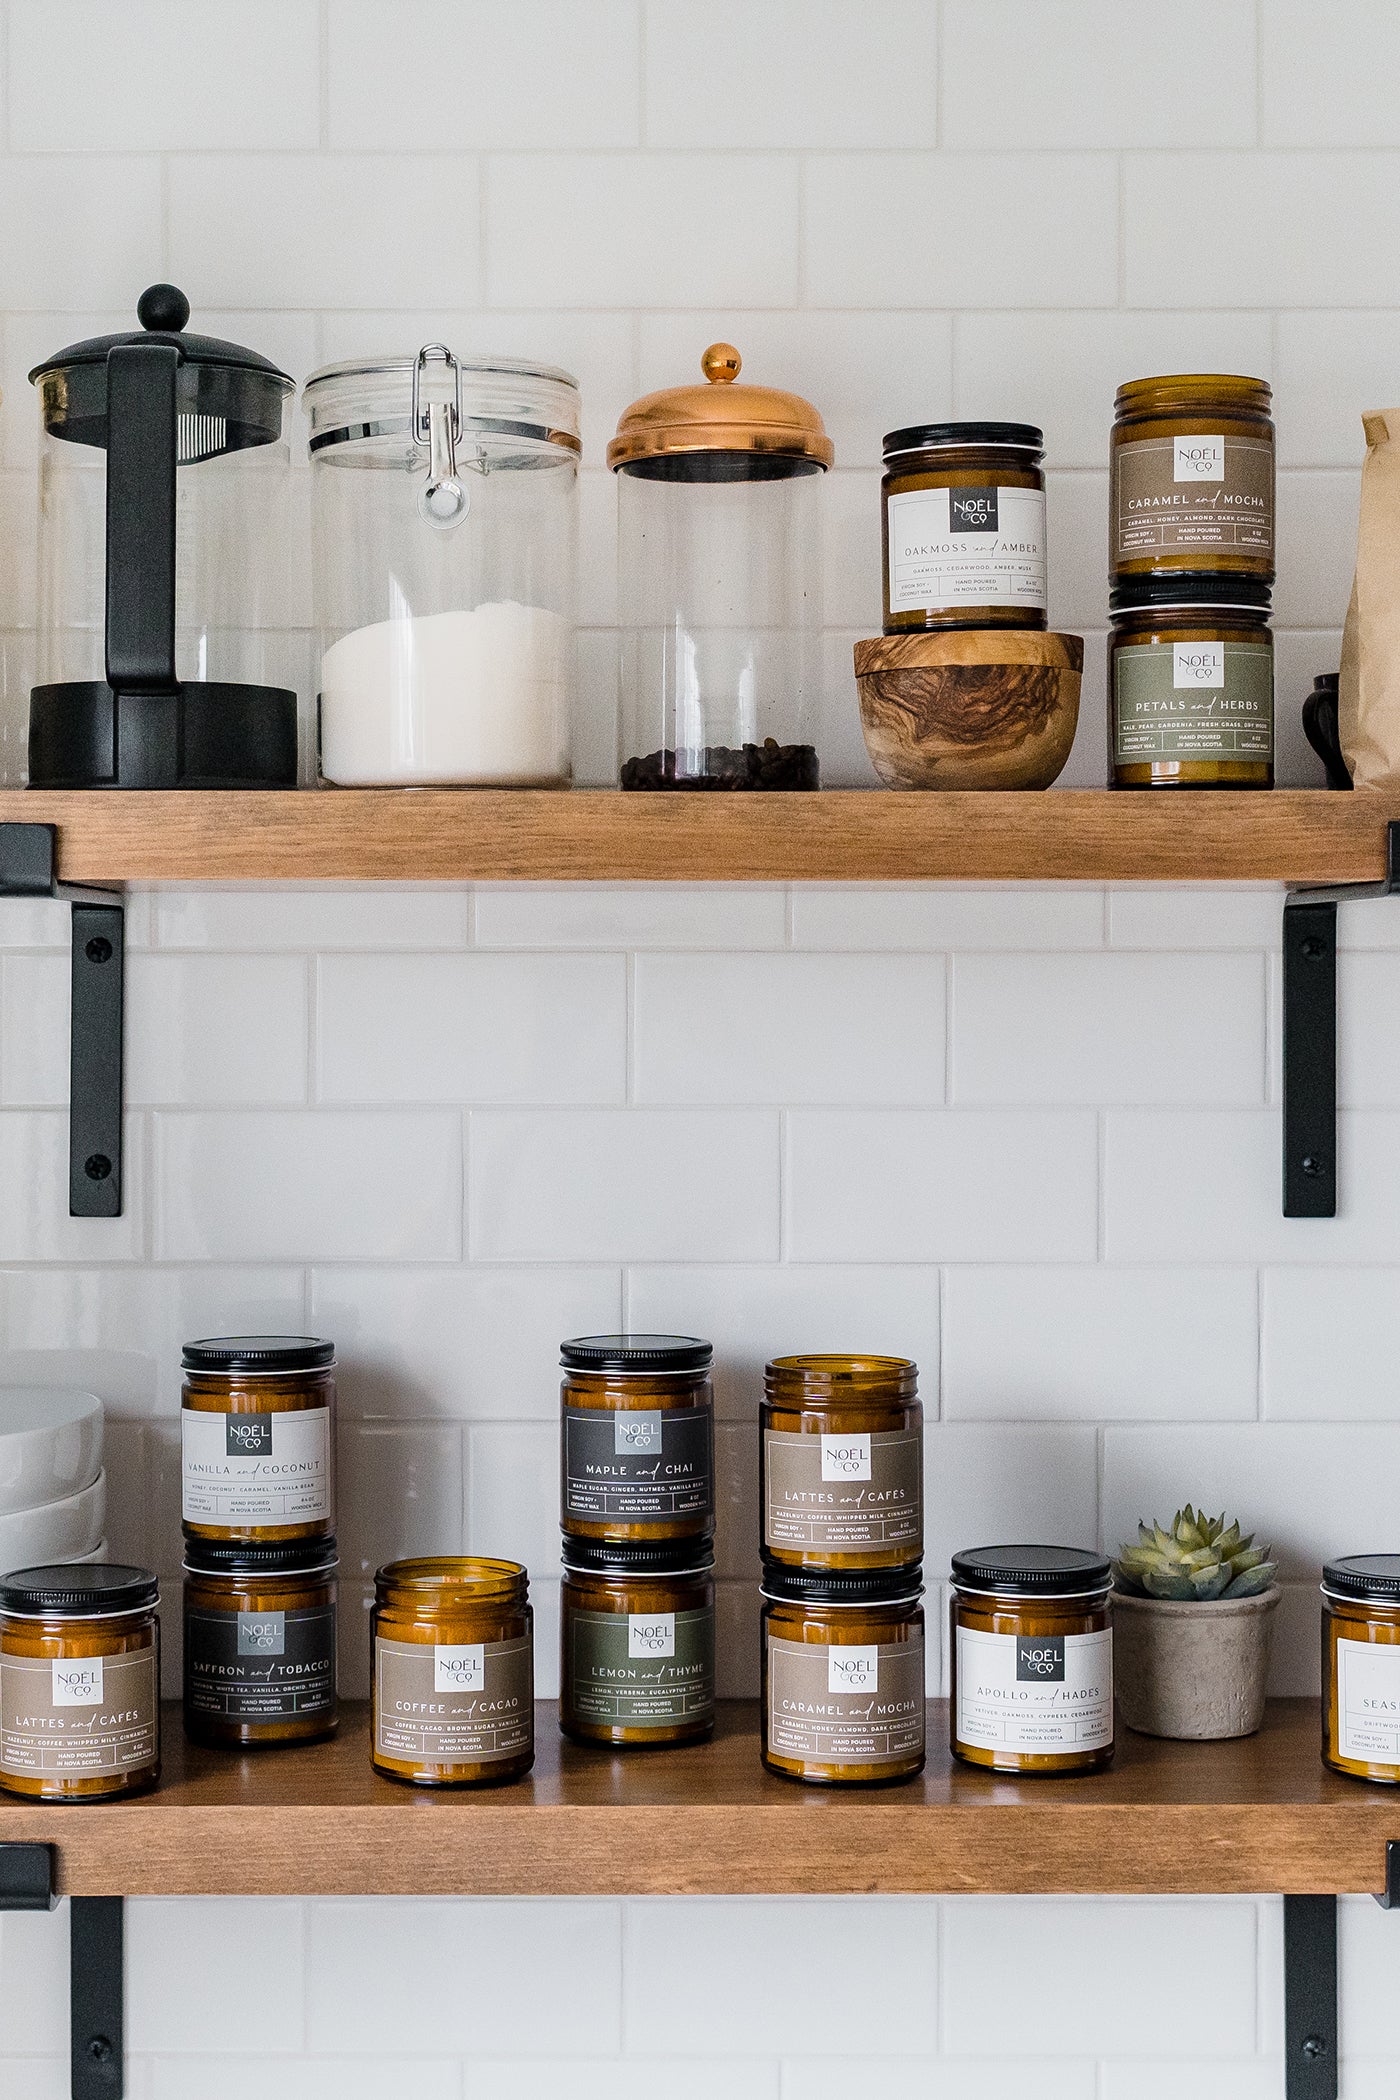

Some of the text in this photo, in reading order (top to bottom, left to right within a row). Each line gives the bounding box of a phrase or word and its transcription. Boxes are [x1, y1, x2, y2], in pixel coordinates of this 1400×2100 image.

[1128, 495, 1189, 510] CARAMEL
[1224, 495, 1264, 507] MOCHA
[905, 543, 967, 557] OAKMOSS
[1001, 543, 1037, 553] AMBER
[1136, 701, 1185, 712] PETALS
[1220, 700, 1258, 710] HERBS
[189, 1463, 230, 1475] VANILLA
[263, 1461, 320, 1474] COCONUT
[586, 1464, 627, 1475] MAPLE
[665, 1463, 693, 1474] CHAI
[785, 1491, 834, 1503] LATTES
[193, 1662, 245, 1676] SAFFRON
[278, 1660, 329, 1675] TOBACCO
[592, 1666, 636, 1678] LEMON
[668, 1663, 704, 1677] THYME
[977, 1687, 1028, 1701] APOLLO
[1062, 1688, 1099, 1700] HADES
[396, 1700, 445, 1714] COFFEE
[479, 1697, 518, 1712] CACAO
[782, 1700, 843, 1716] CARAMEL
[877, 1700, 915, 1715] MOCHA
[1363, 1699, 1400, 1710] SEAS
[15, 1716, 65, 1728] LATTES
